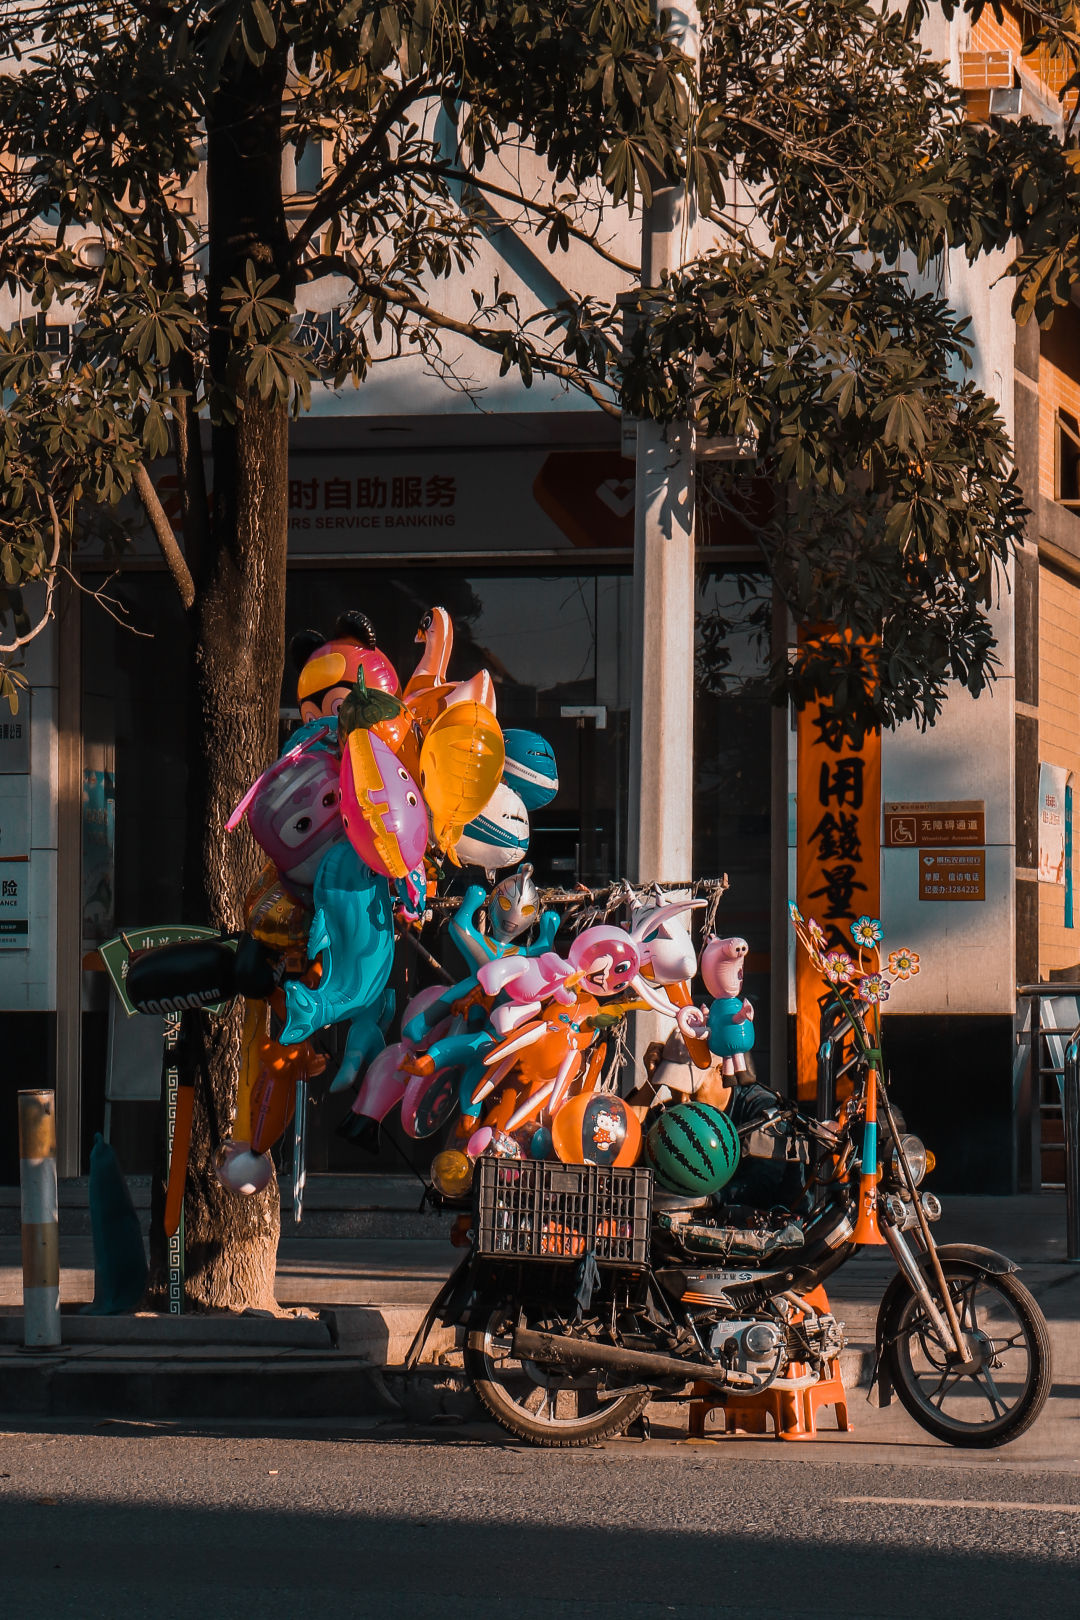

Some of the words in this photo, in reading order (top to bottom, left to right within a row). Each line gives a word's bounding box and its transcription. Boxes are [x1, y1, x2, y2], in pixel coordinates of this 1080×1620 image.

[288, 517, 311, 529] RS
[315, 516, 381, 528] SERVICE
[384, 514, 456, 528] BANKING
[921, 819, 978, 830] 无障碍通道
[2, 880, 18, 896] 险
